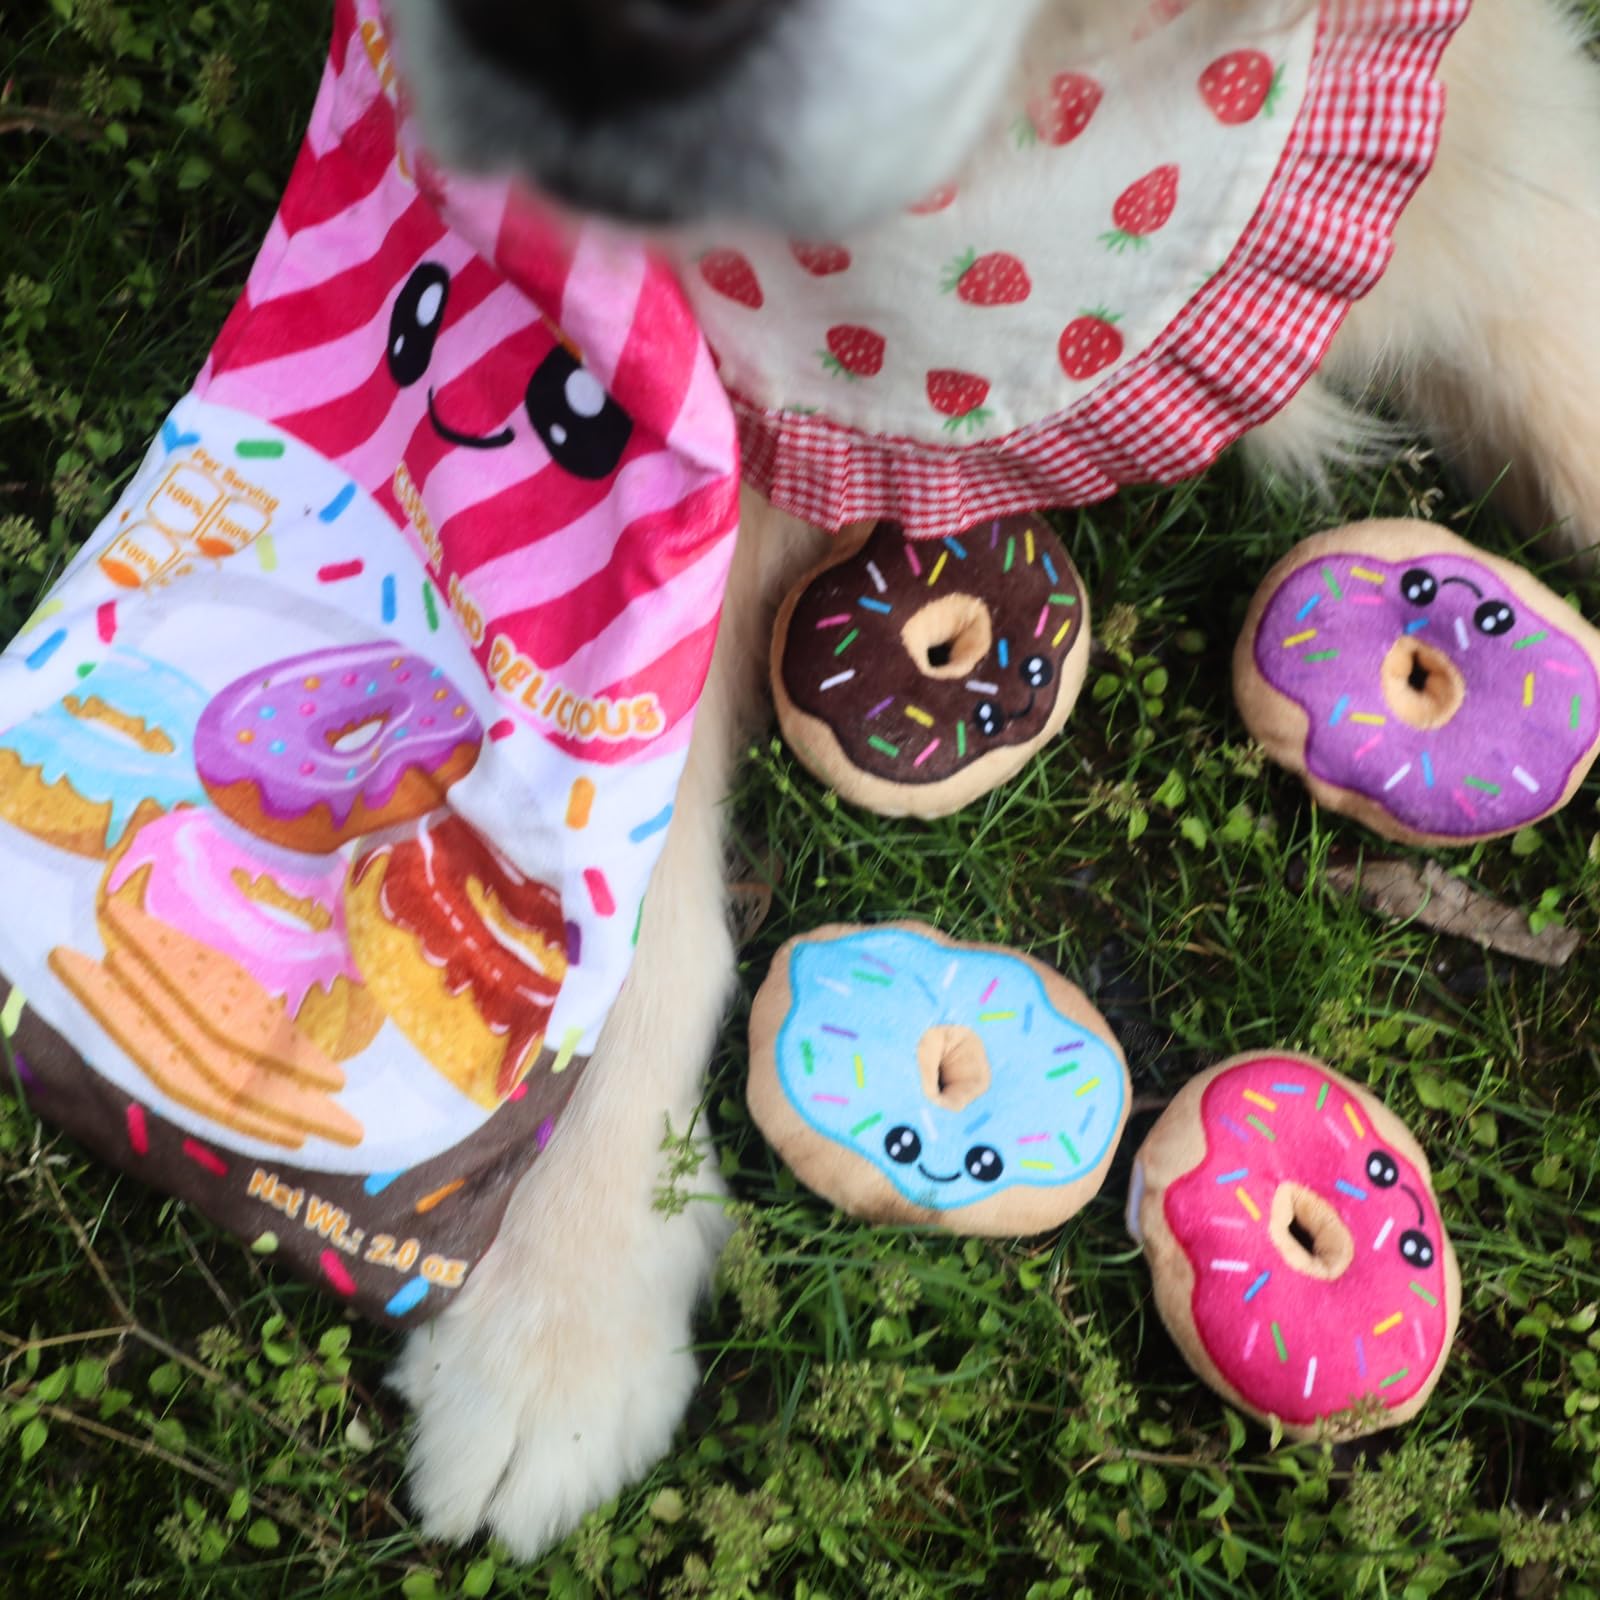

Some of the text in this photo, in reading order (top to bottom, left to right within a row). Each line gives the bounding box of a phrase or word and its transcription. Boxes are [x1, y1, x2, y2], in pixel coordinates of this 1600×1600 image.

[488, 634, 665, 741] DELICIOUS
[247, 1167, 304, 1220] Net
[364, 1233, 420, 1273] 2.0
[420, 1253, 468, 1288] oz
